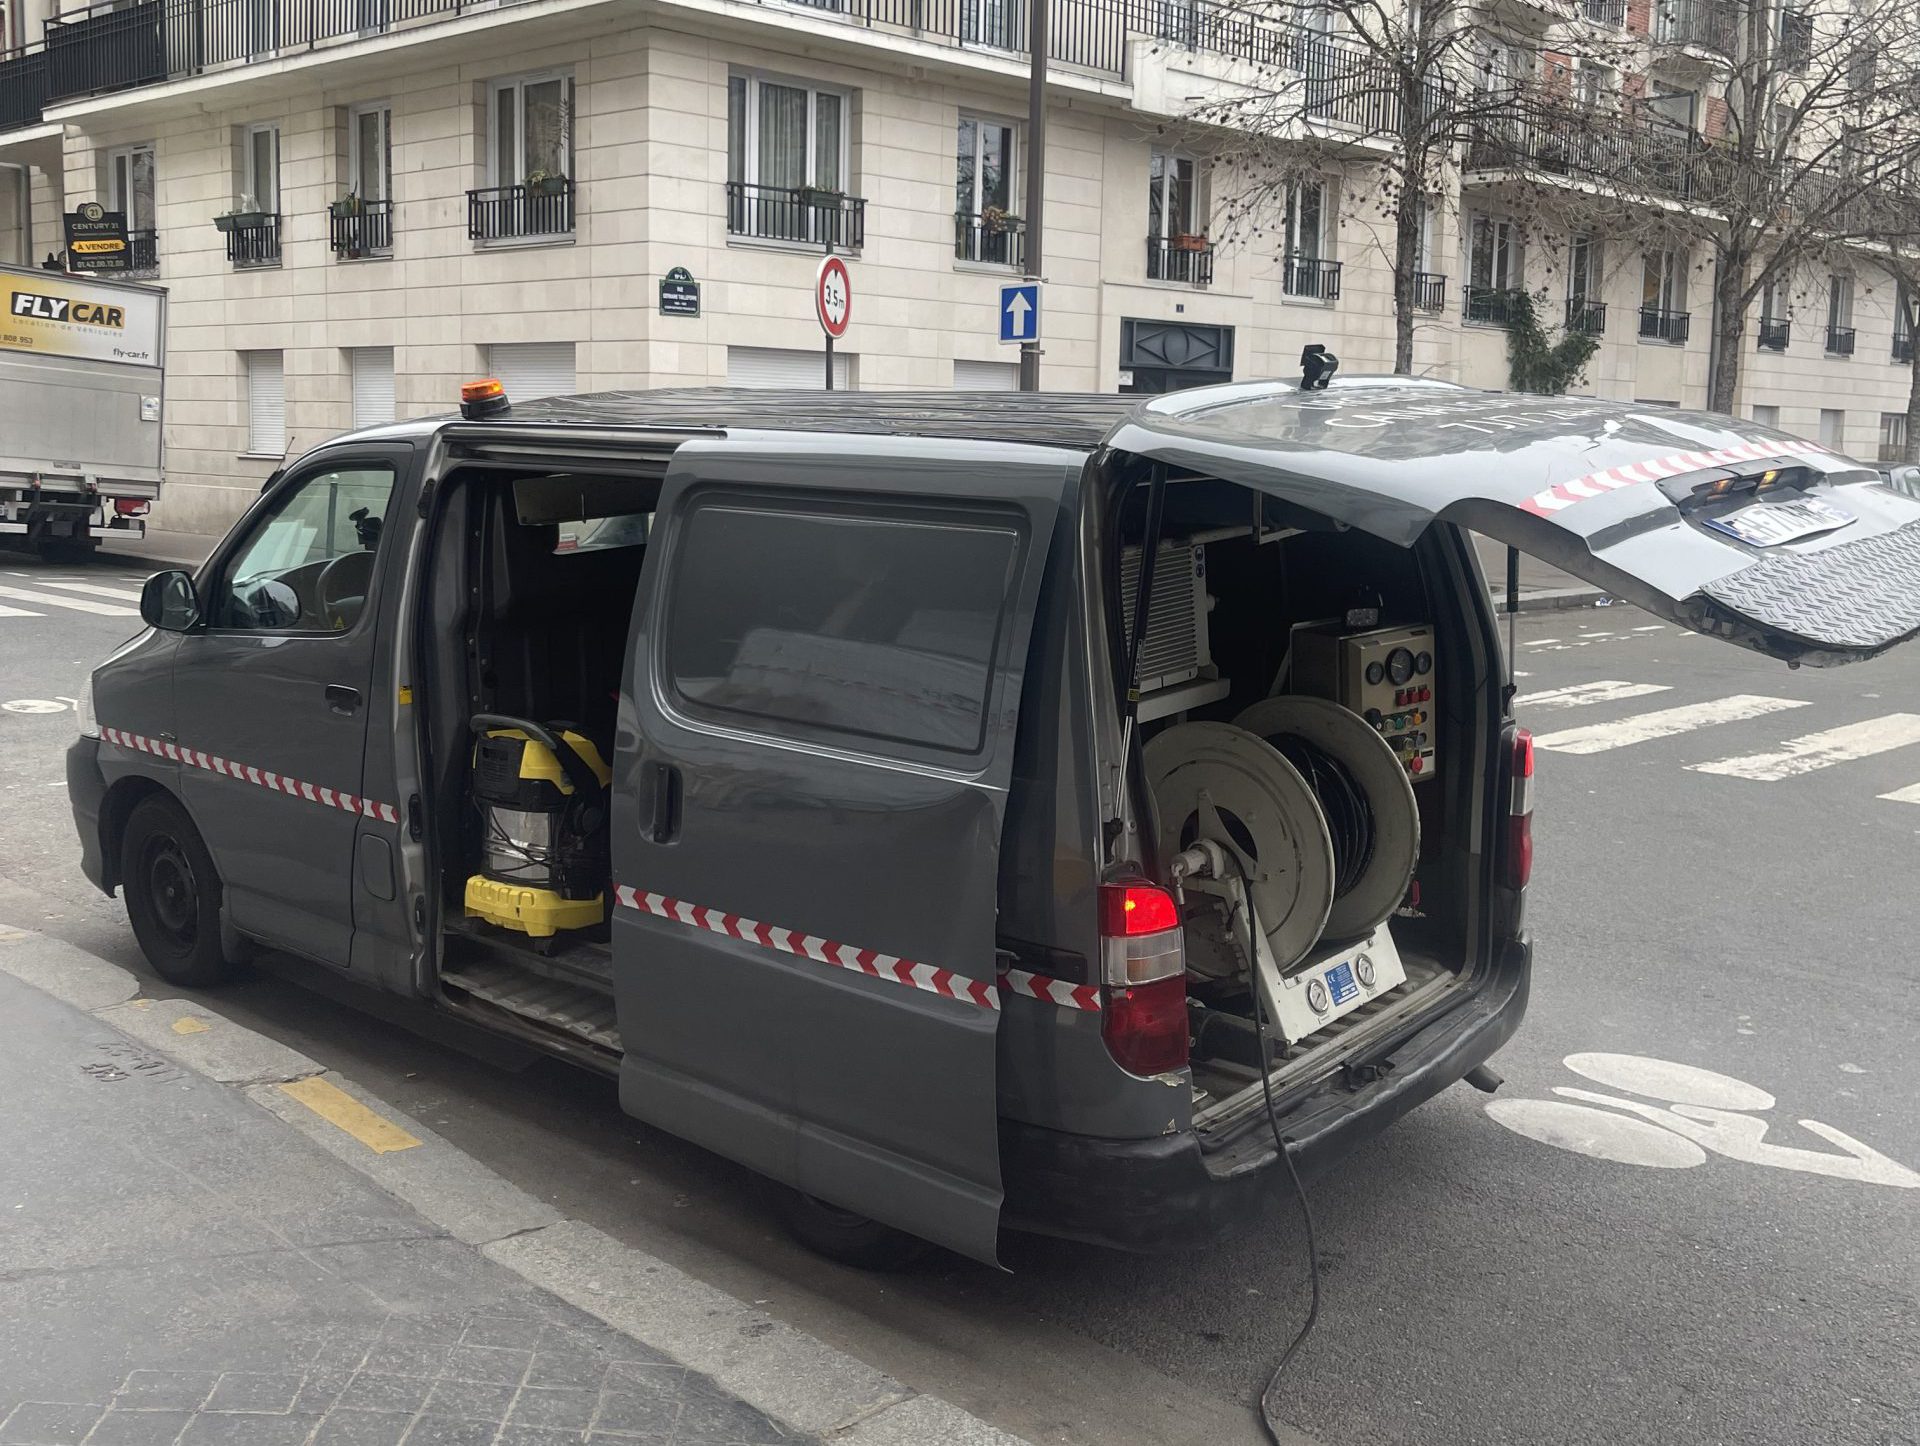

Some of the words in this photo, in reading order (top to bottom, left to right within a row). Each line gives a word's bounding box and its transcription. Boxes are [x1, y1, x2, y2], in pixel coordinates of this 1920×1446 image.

[89, 208, 98, 216] 21
[72, 222, 109, 230] CENTURY
[85, 242, 120, 250] VENDRE
[14, 293, 69, 319] FLY
[72, 304, 122, 327] CAR
[12, 317, 57, 329] Location
[113, 348, 149, 360] fly-car.fr
